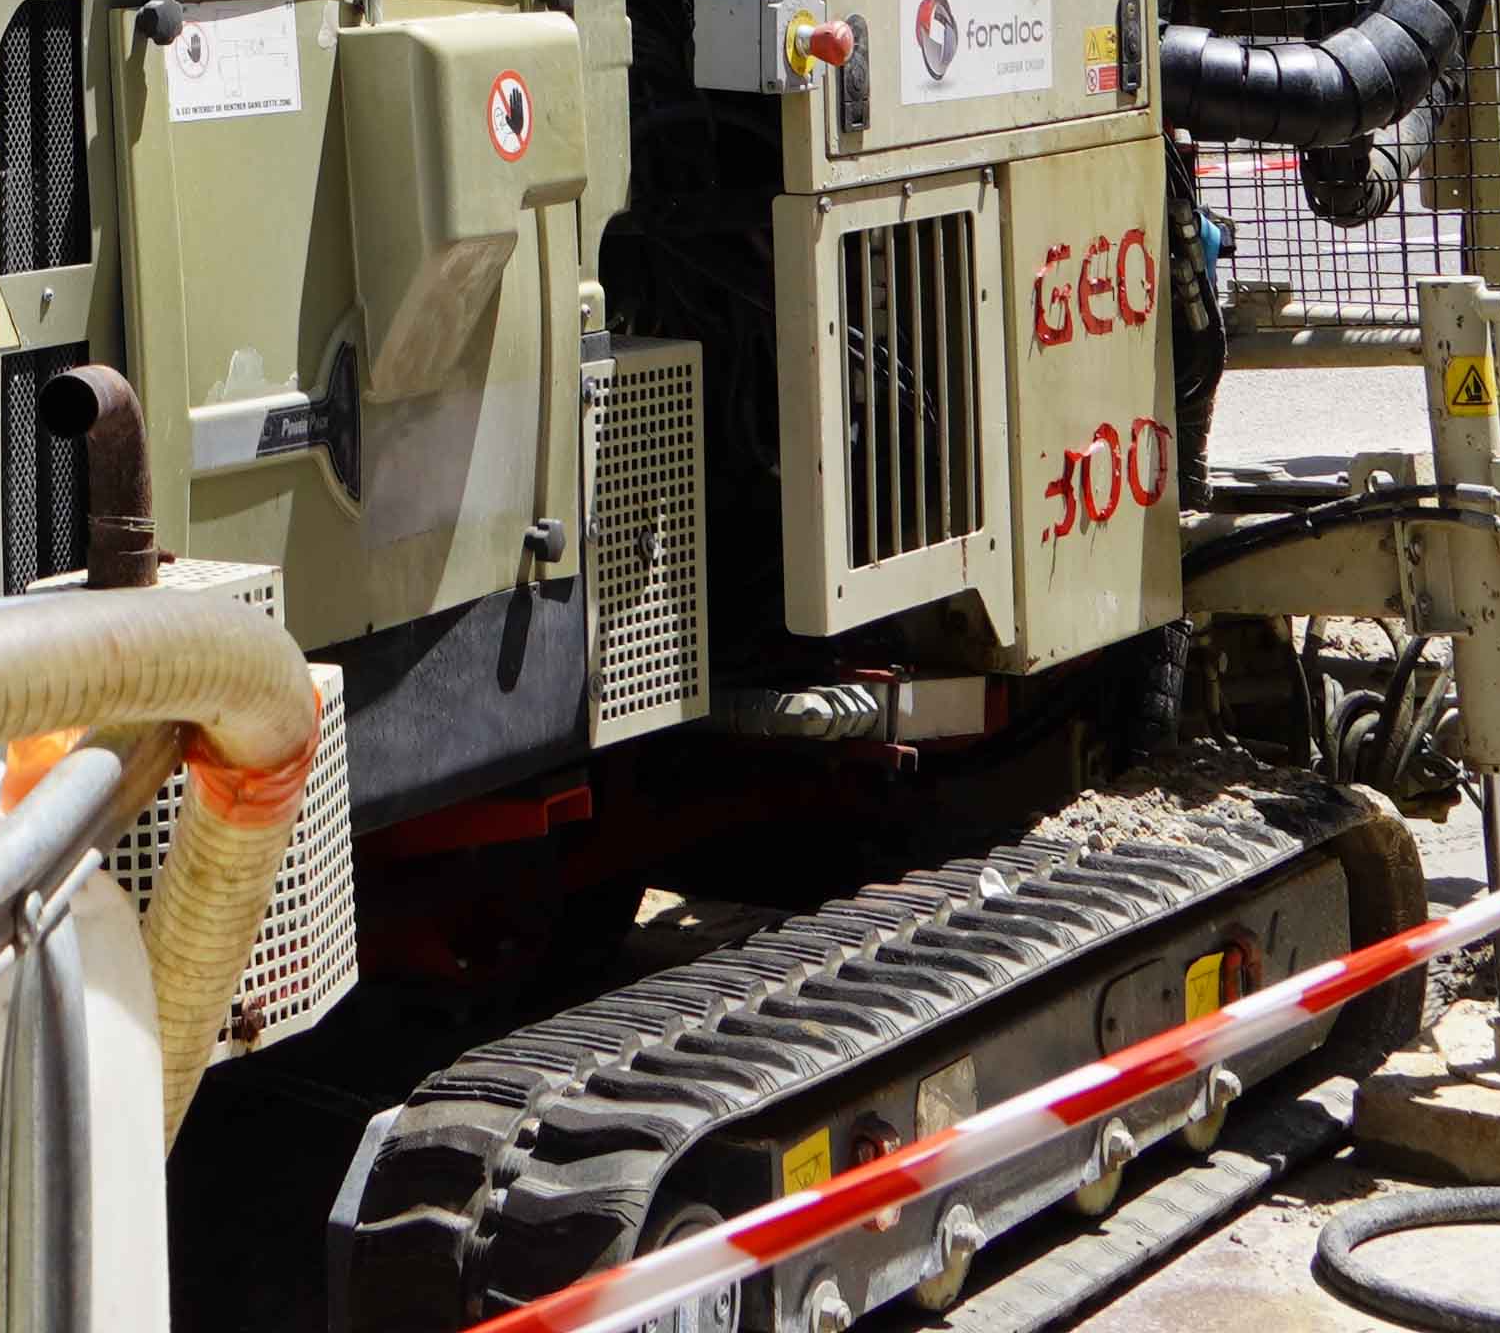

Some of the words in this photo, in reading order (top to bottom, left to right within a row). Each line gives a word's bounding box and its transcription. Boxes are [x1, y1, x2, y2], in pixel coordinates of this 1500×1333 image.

[966, 13, 1044, 49] foraloc
[1033, 228, 1155, 347] GEO
[1040, 417, 1172, 543] 300
